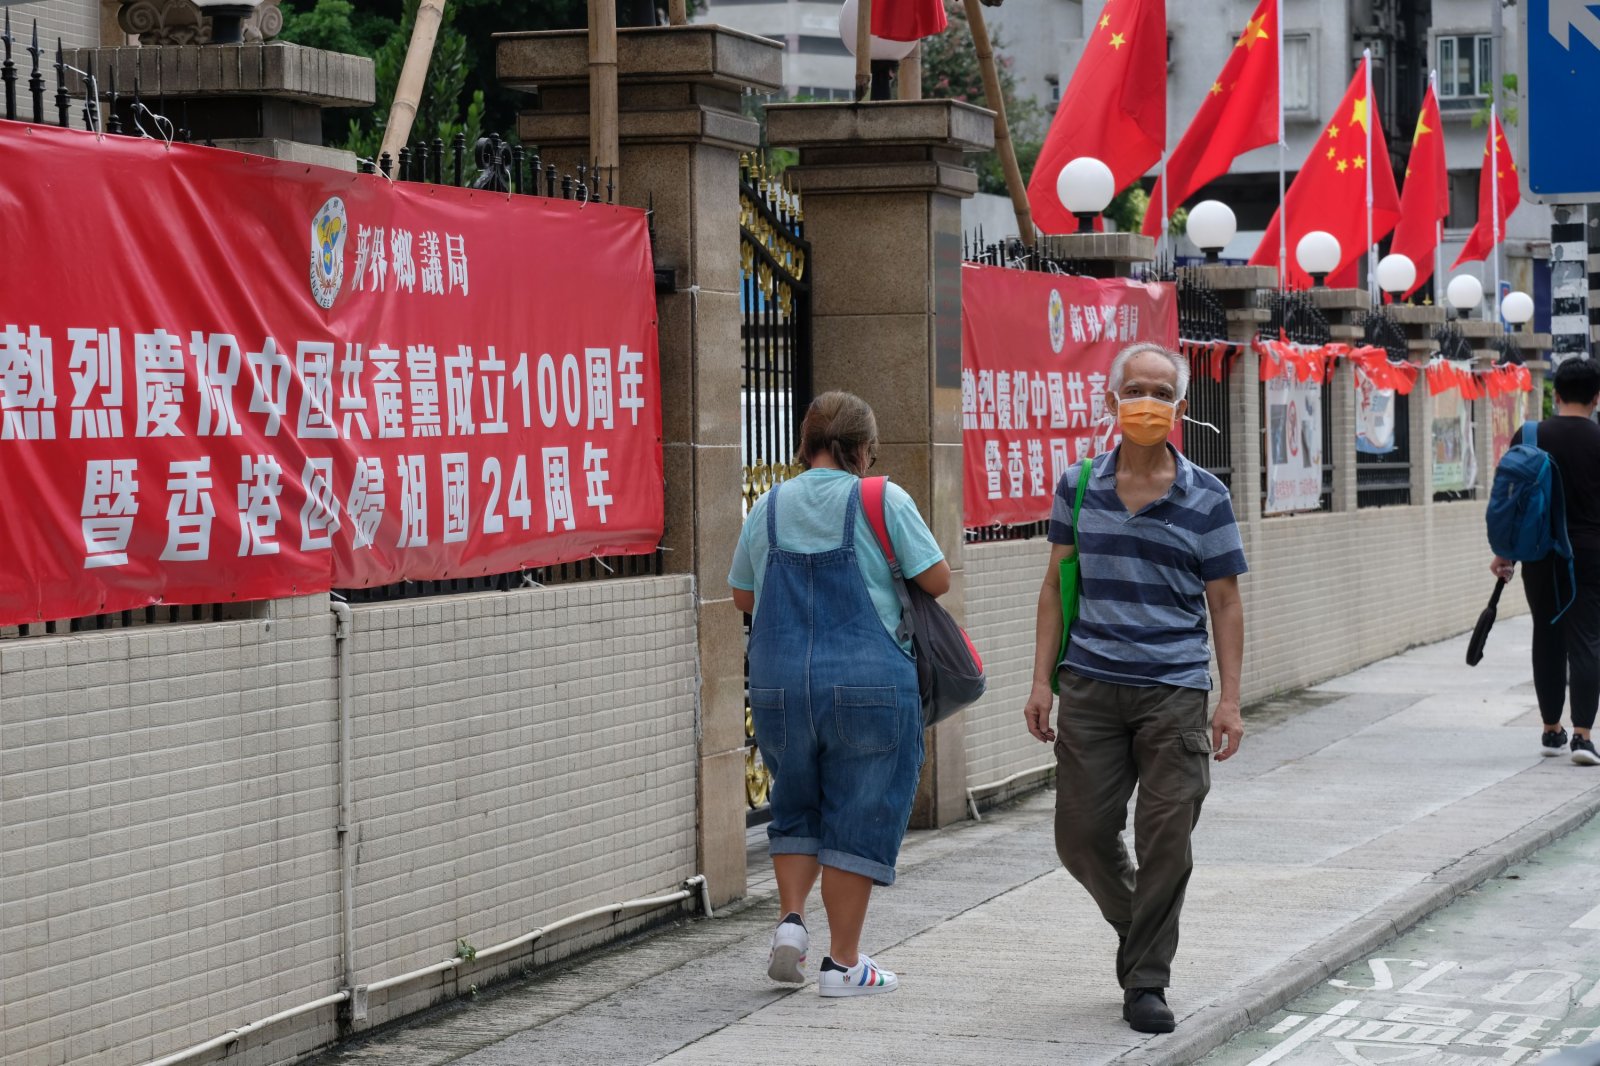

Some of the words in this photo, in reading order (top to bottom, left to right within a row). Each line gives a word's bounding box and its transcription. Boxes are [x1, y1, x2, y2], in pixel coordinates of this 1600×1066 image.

[351, 223, 469, 297] 新界鄉議局
[962, 368, 1116, 430] 熱烈慶祝中國共產
[1327, 957, 1600, 1008] SLO
